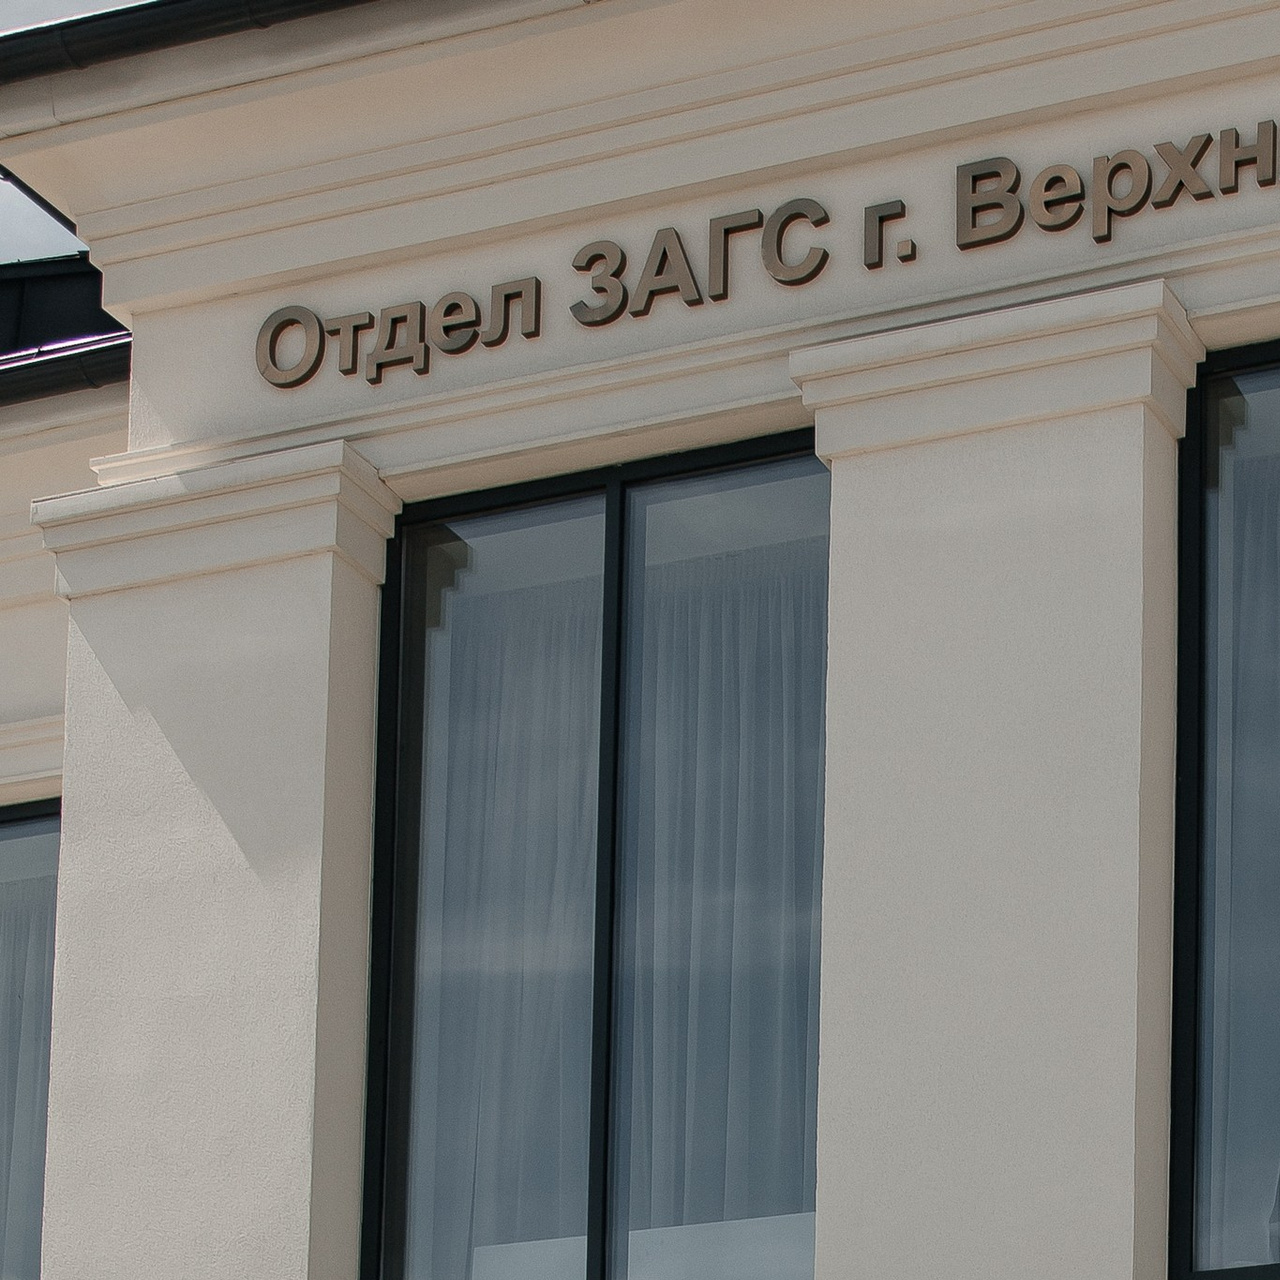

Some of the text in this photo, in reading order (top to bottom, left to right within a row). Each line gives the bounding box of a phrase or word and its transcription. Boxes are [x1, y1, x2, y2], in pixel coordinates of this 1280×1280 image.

[256, 277, 541, 388] Отдел
[569, 197, 831, 328] ЗАГС
[864, 200, 917, 270] г.
